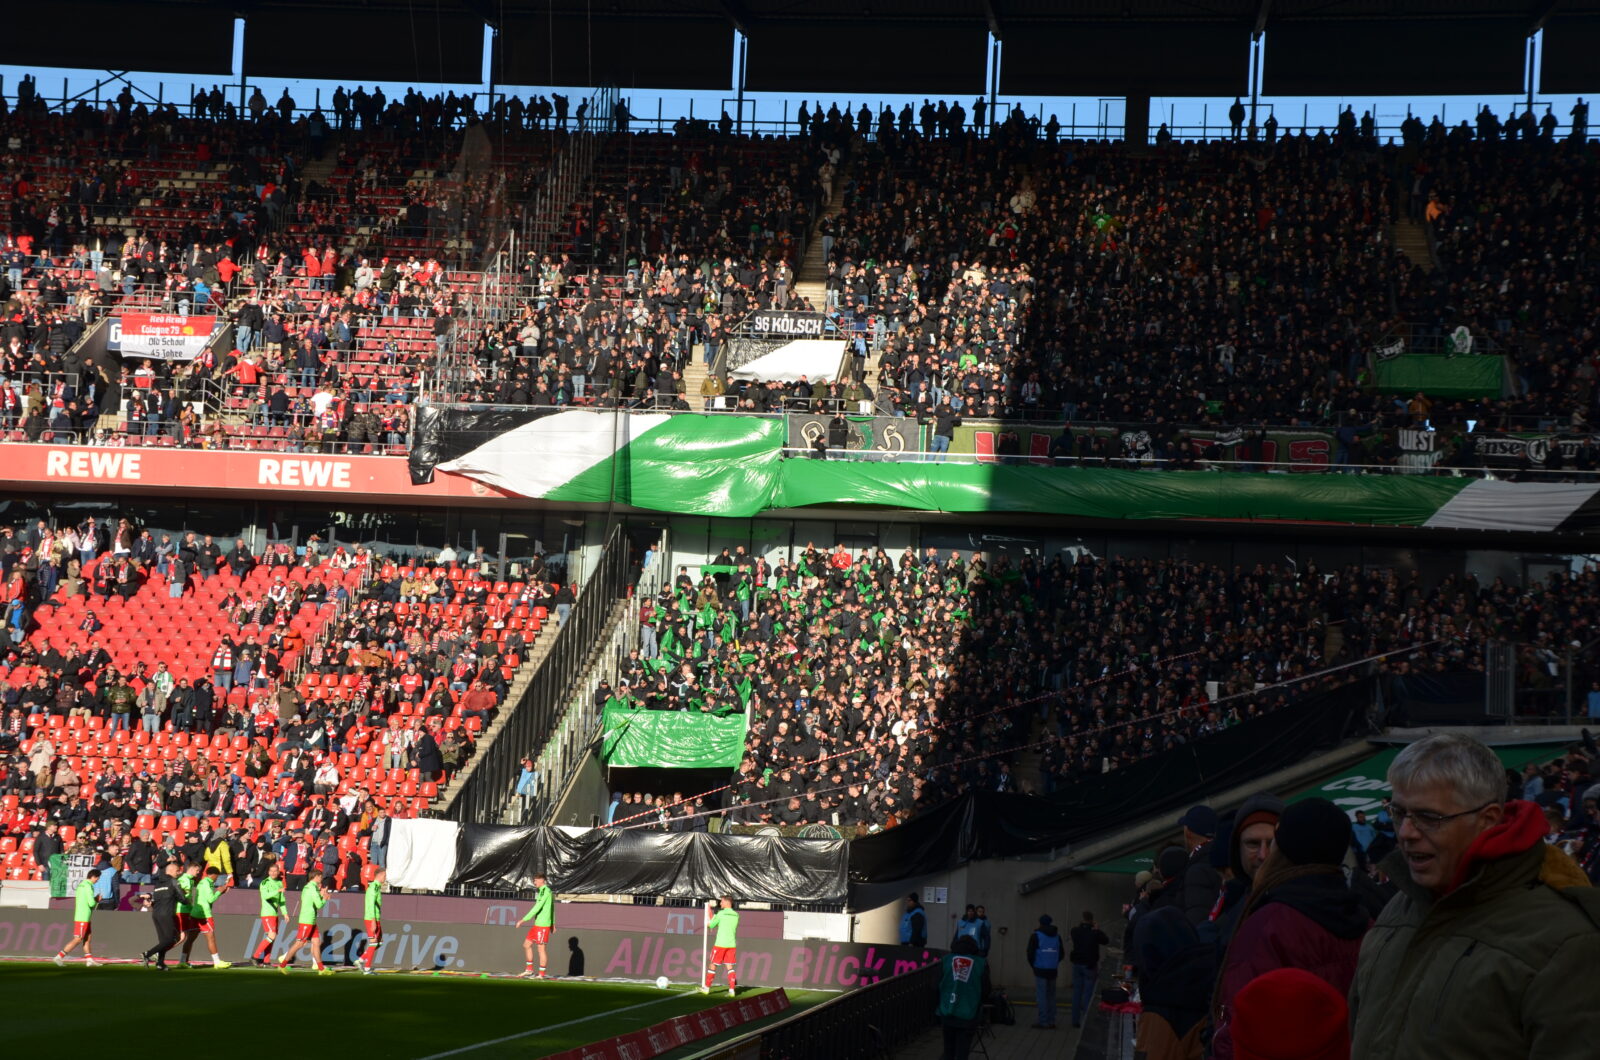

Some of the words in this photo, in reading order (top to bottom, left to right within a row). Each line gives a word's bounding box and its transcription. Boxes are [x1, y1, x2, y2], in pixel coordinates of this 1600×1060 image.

[141, 325, 170, 335] Cologne
[170, 326, 180, 335] 79
[754, 316, 769, 331] 96
[771, 313, 822, 334] KÖLSCH
[161, 337, 185, 346] School
[162, 349, 183, 358] Jahre
[1398, 429, 1437, 452] WEST
[46, 450, 142, 480] REWE
[258, 459, 352, 488] REWE
[488, 905, 518, 926] T
[667, 913, 695, 934] T
[605, 936, 709, 979] Alles
[784, 943, 887, 987] Blick
